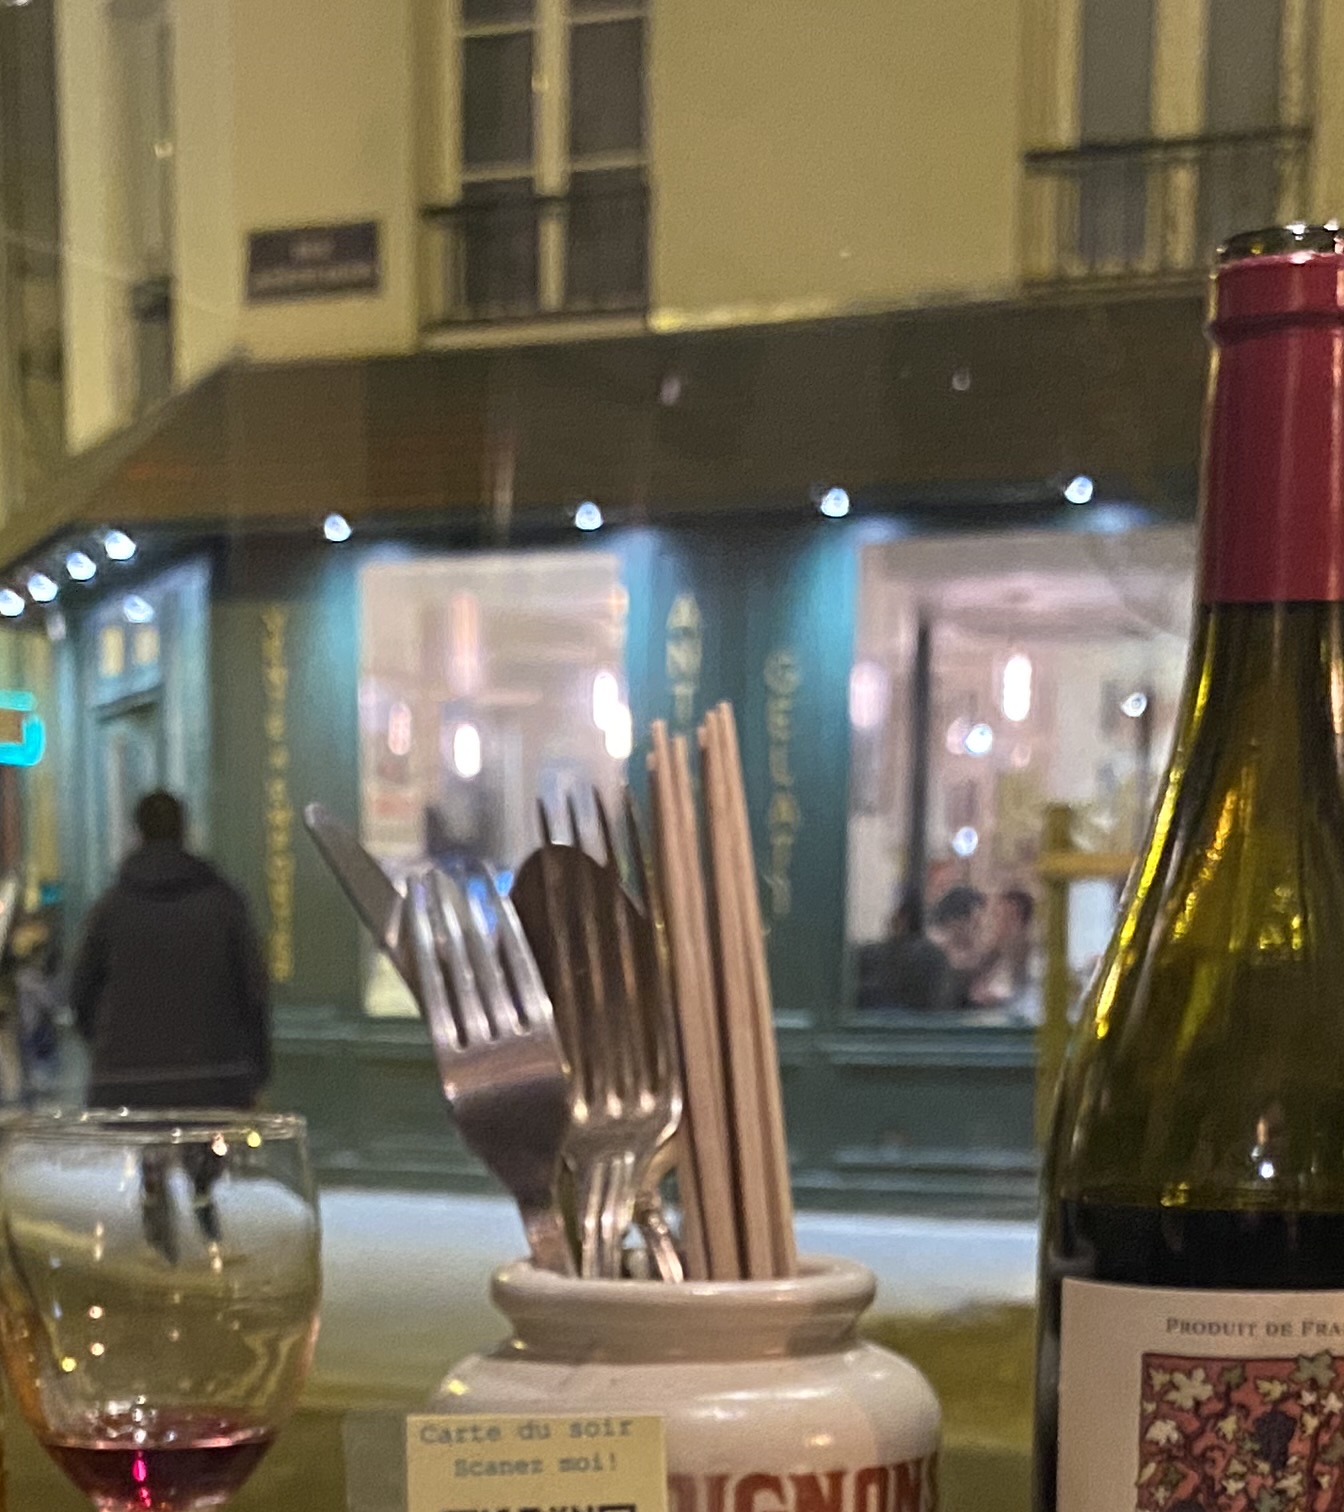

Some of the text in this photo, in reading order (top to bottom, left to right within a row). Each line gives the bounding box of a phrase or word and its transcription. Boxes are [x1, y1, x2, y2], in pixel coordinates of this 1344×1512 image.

[1166, 1317, 1258, 1337] PRODUIT
[1265, 1321, 1293, 1337] DE
[419, 1417, 633, 1445] Carte du soir
[453, 1451, 617, 1478] Scanez moi!
